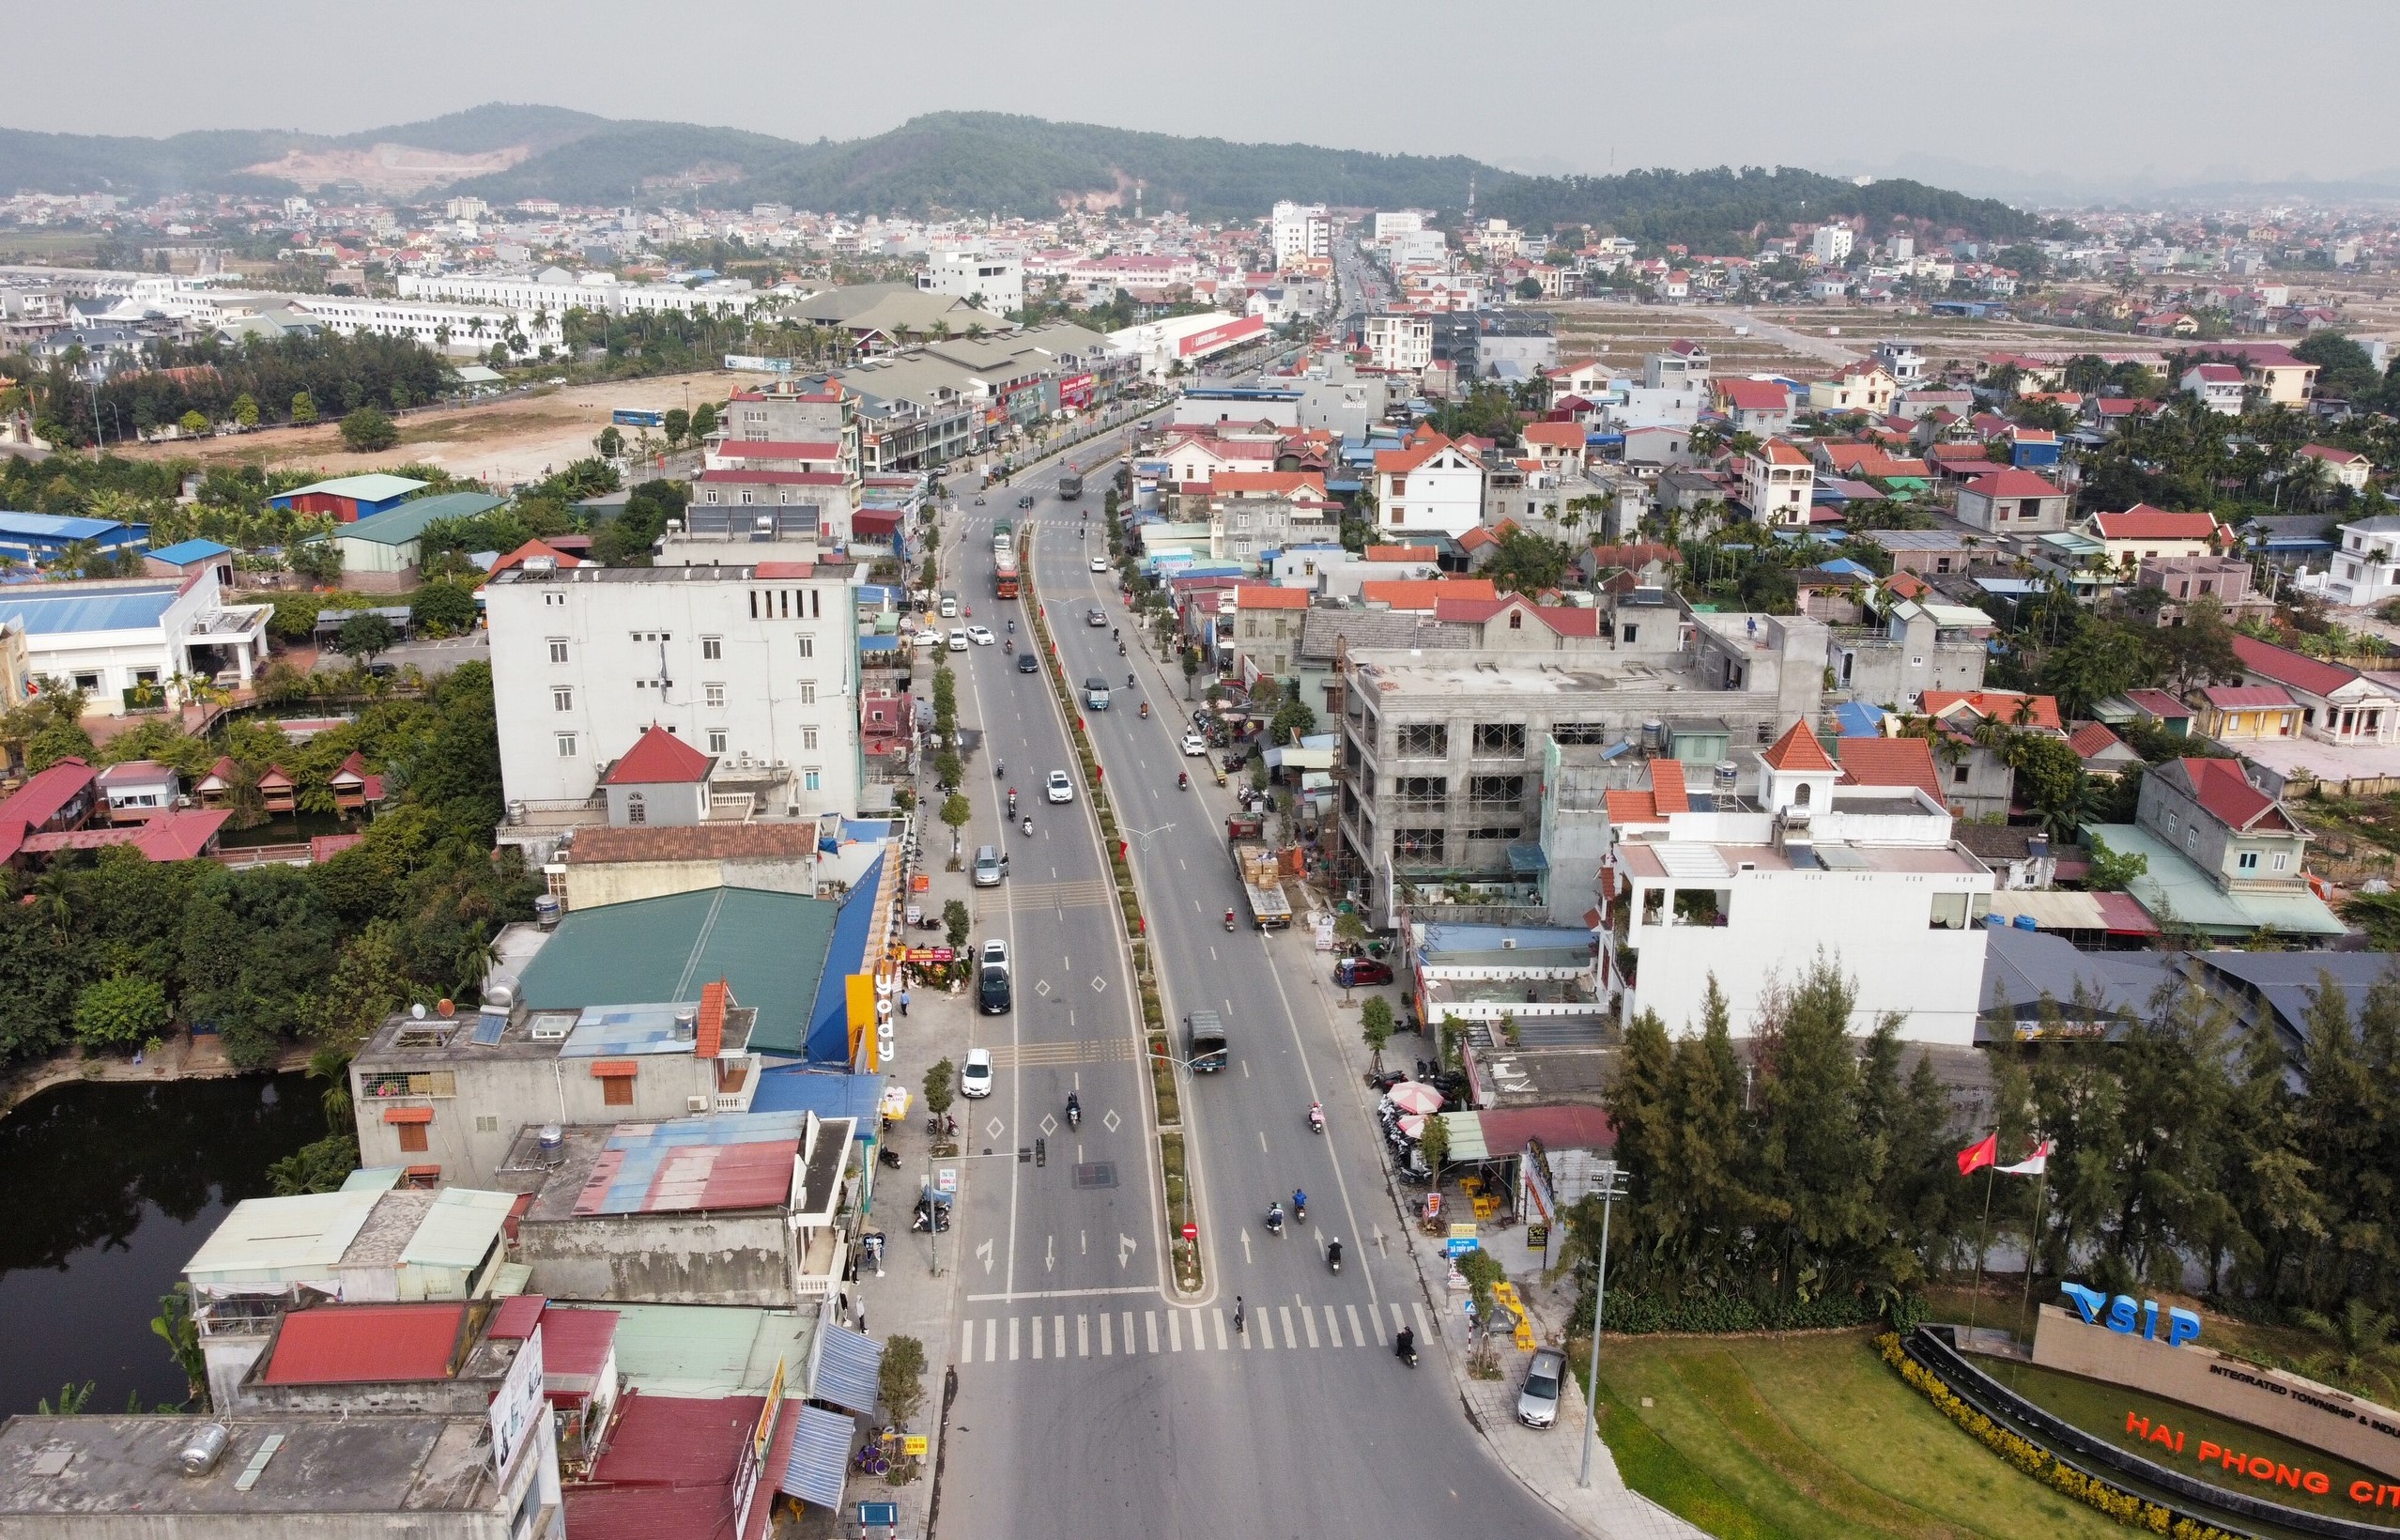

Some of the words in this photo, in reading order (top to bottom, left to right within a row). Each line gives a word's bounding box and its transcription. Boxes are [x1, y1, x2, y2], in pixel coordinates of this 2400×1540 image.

[875, 974, 894, 1061] yody
[2209, 1364, 2287, 1395] INTEGRATED
[2291, 1390, 2356, 1420] TOWNSHIP
[2359, 1415, 2368, 1425] &
[2126, 1411, 2185, 1453] HAI
[2198, 1440, 2331, 1494] PHONG
